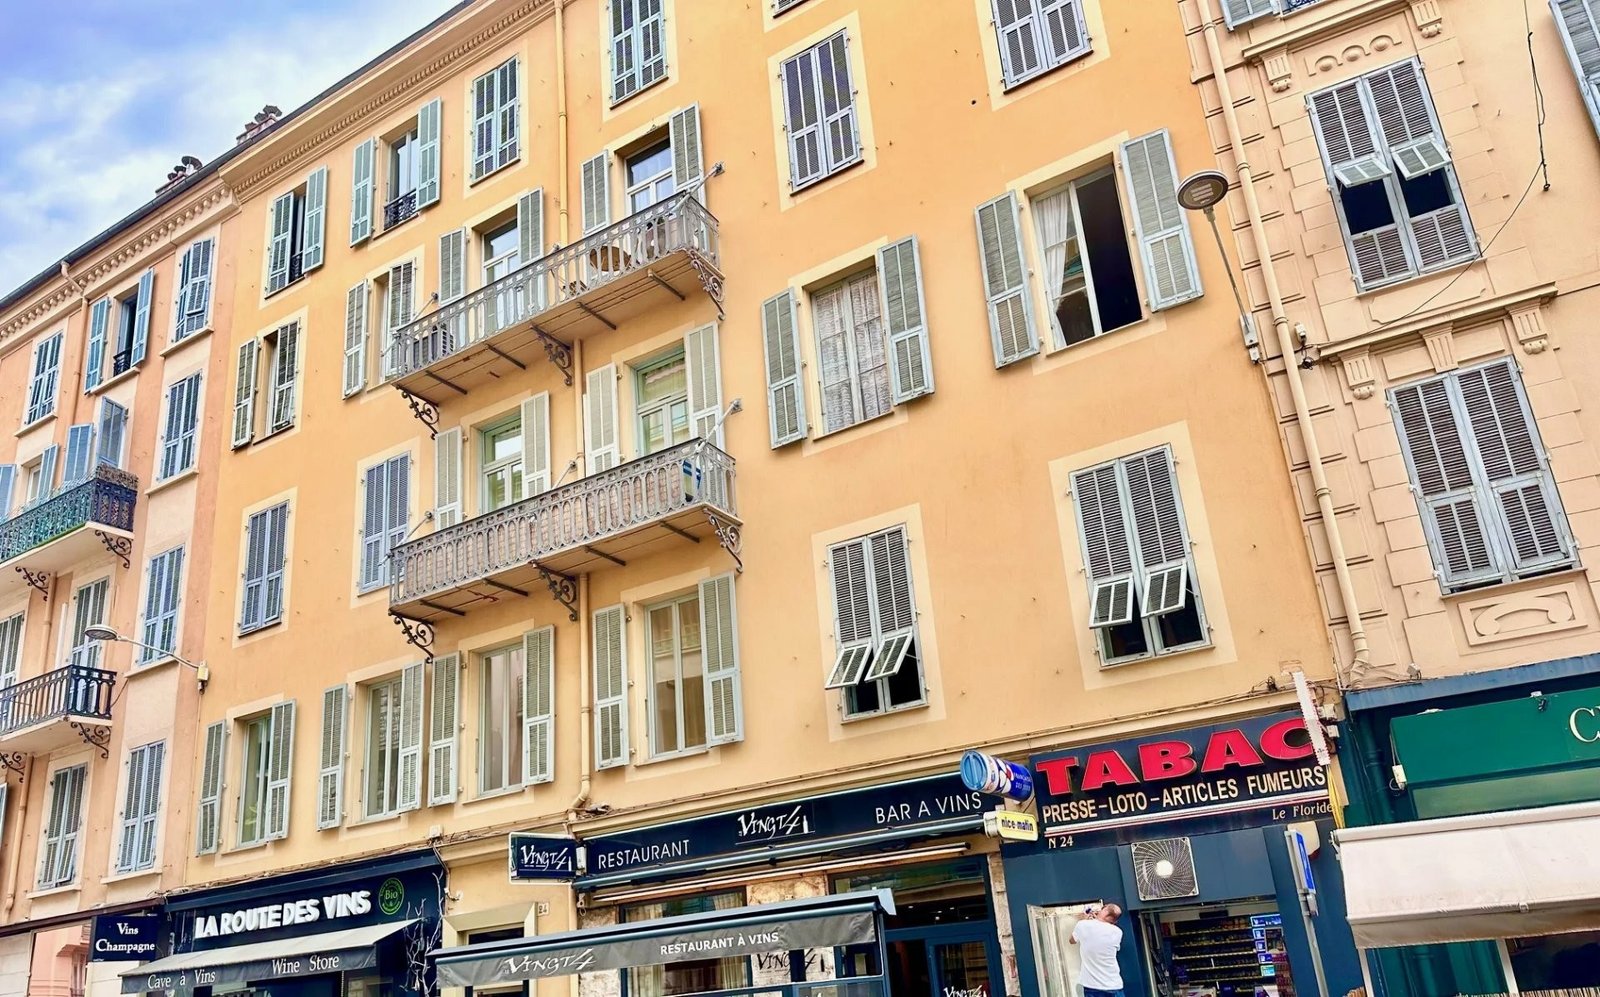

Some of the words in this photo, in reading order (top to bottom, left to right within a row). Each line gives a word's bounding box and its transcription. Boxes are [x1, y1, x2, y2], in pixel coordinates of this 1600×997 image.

[1569, 705, 1600, 743] C
[1035, 717, 1313, 795] TABAC
[1247, 765, 1326, 795] FUMEURS
[875, 803, 911, 824] BAR
[918, 800, 931, 818] A
[935, 791, 982, 814] VINS
[1272, 808, 1286, 820] Le
[1293, 801, 1333, 818] Floride
[598, 839, 690, 870] RESTAURANT
[1060, 835, 1075, 848] 24
[385, 889, 398, 900] Bio
[117, 922, 139, 935] Vins
[195, 915, 219, 939] LA
[220, 904, 282, 936] ROUTE
[282, 899, 320, 926] DES
[322, 890, 372, 919] VINS
[95, 939, 155, 954] Champagne
[660, 937, 735, 955] RESTAURANT
[737, 933, 746, 946] À
[749, 932, 780, 945] VINS
[147, 974, 171, 989] Cave
[180, 971, 186, 986] à
[194, 969, 216, 984] Vins
[272, 959, 300, 975] Wine
[309, 954, 340, 971] Store
